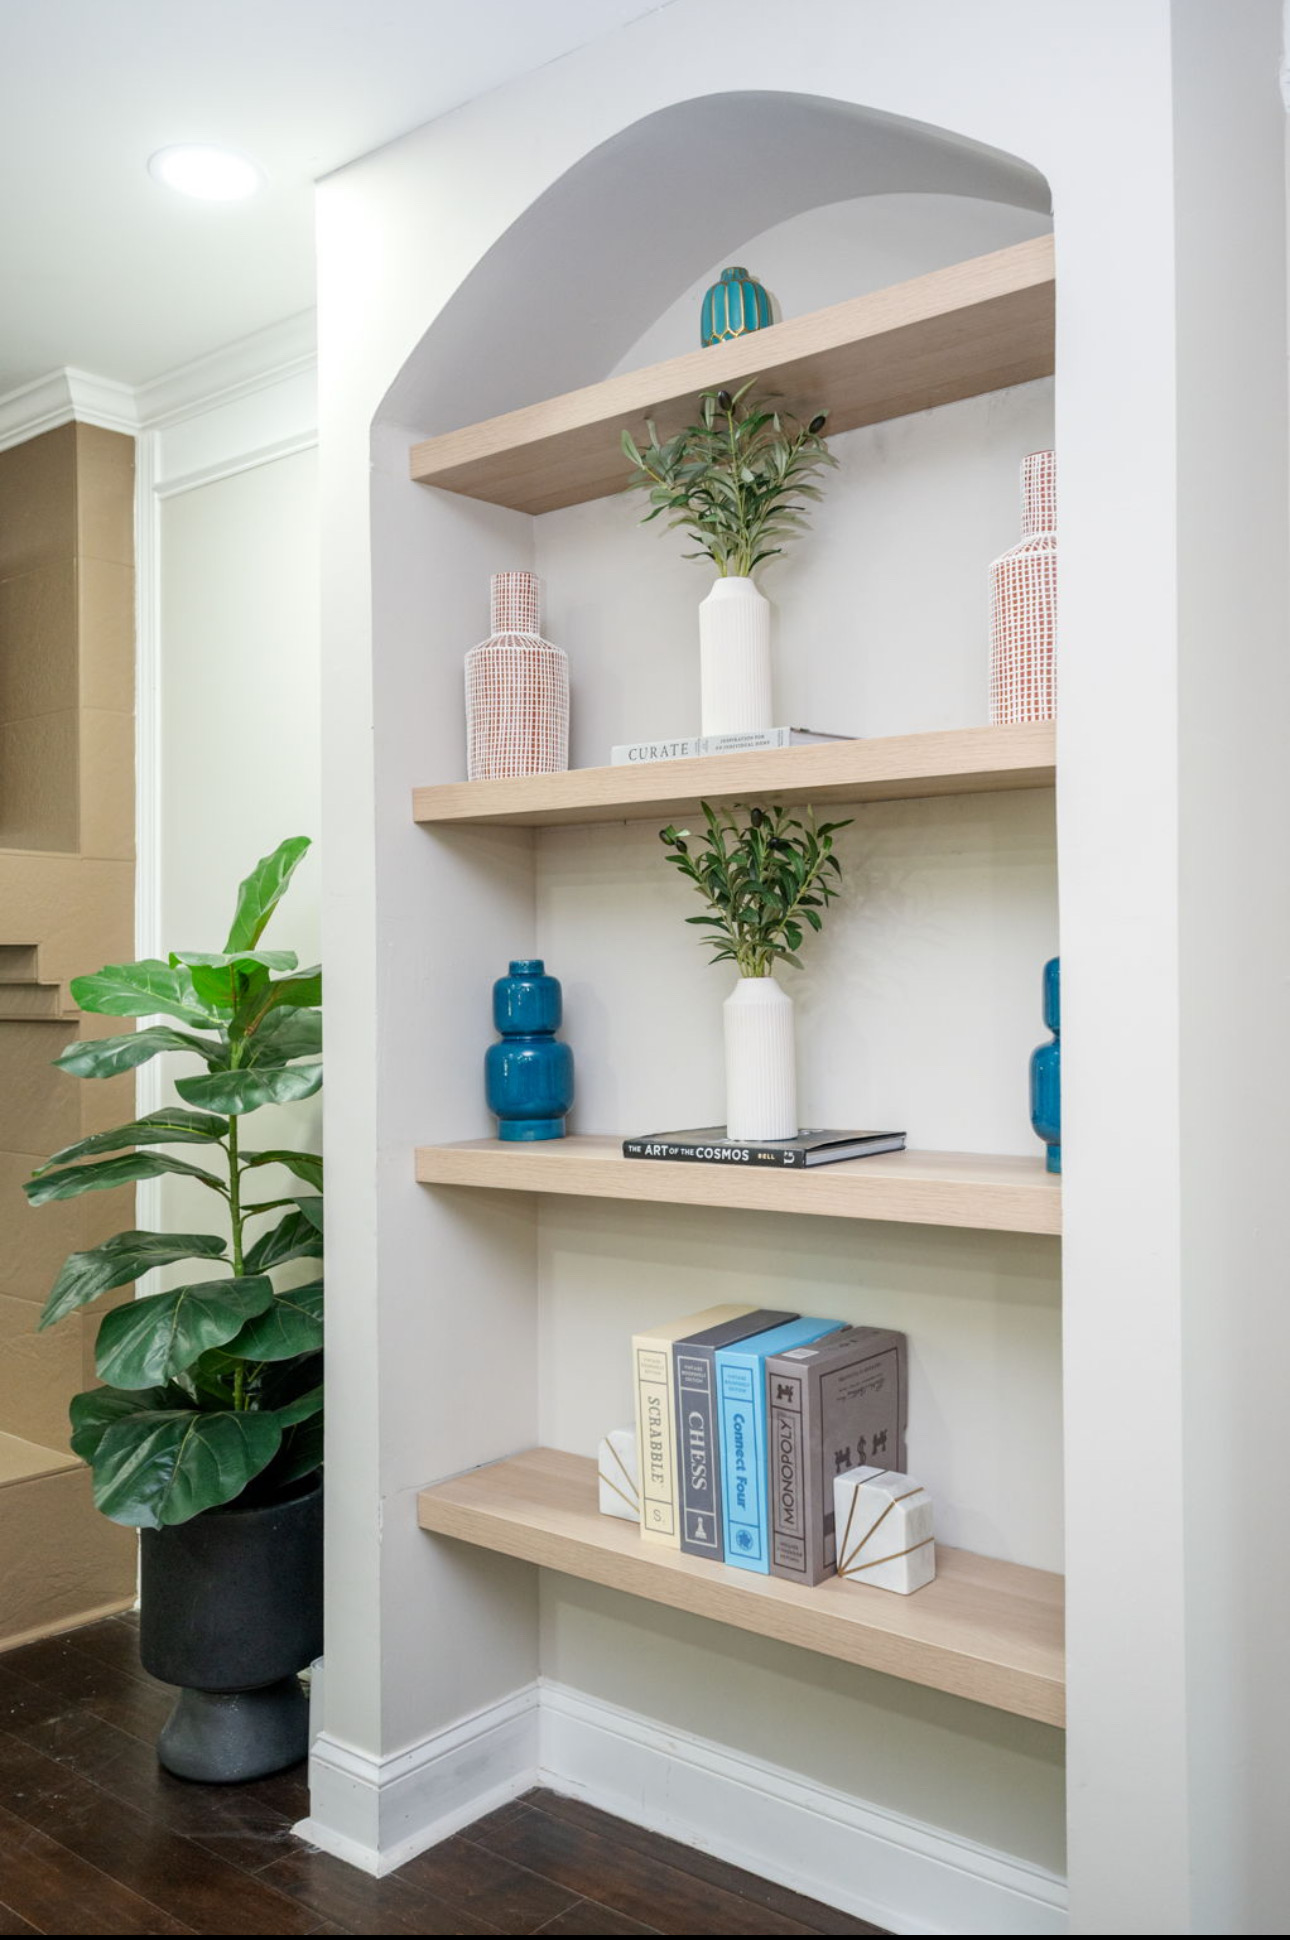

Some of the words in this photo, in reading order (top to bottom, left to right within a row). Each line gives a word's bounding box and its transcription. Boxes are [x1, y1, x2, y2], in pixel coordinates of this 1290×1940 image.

[628, 742, 689, 761] CURATE
[628, 1145, 642, 1153] THE
[644, 1144, 668, 1157] ART
[669, 1147, 679, 1155] OF
[680, 1148, 695, 1156] THE
[695, 1147, 750, 1161] COSMOS
[647, 1395, 665, 1484] SCRABBLE
[688, 1411, 708, 1491] CHESS
[733, 1413, 746, 1472] Connect
[736, 1475, 747, 1511] Four
[780, 1419, 795, 1525] MONOPOLY
